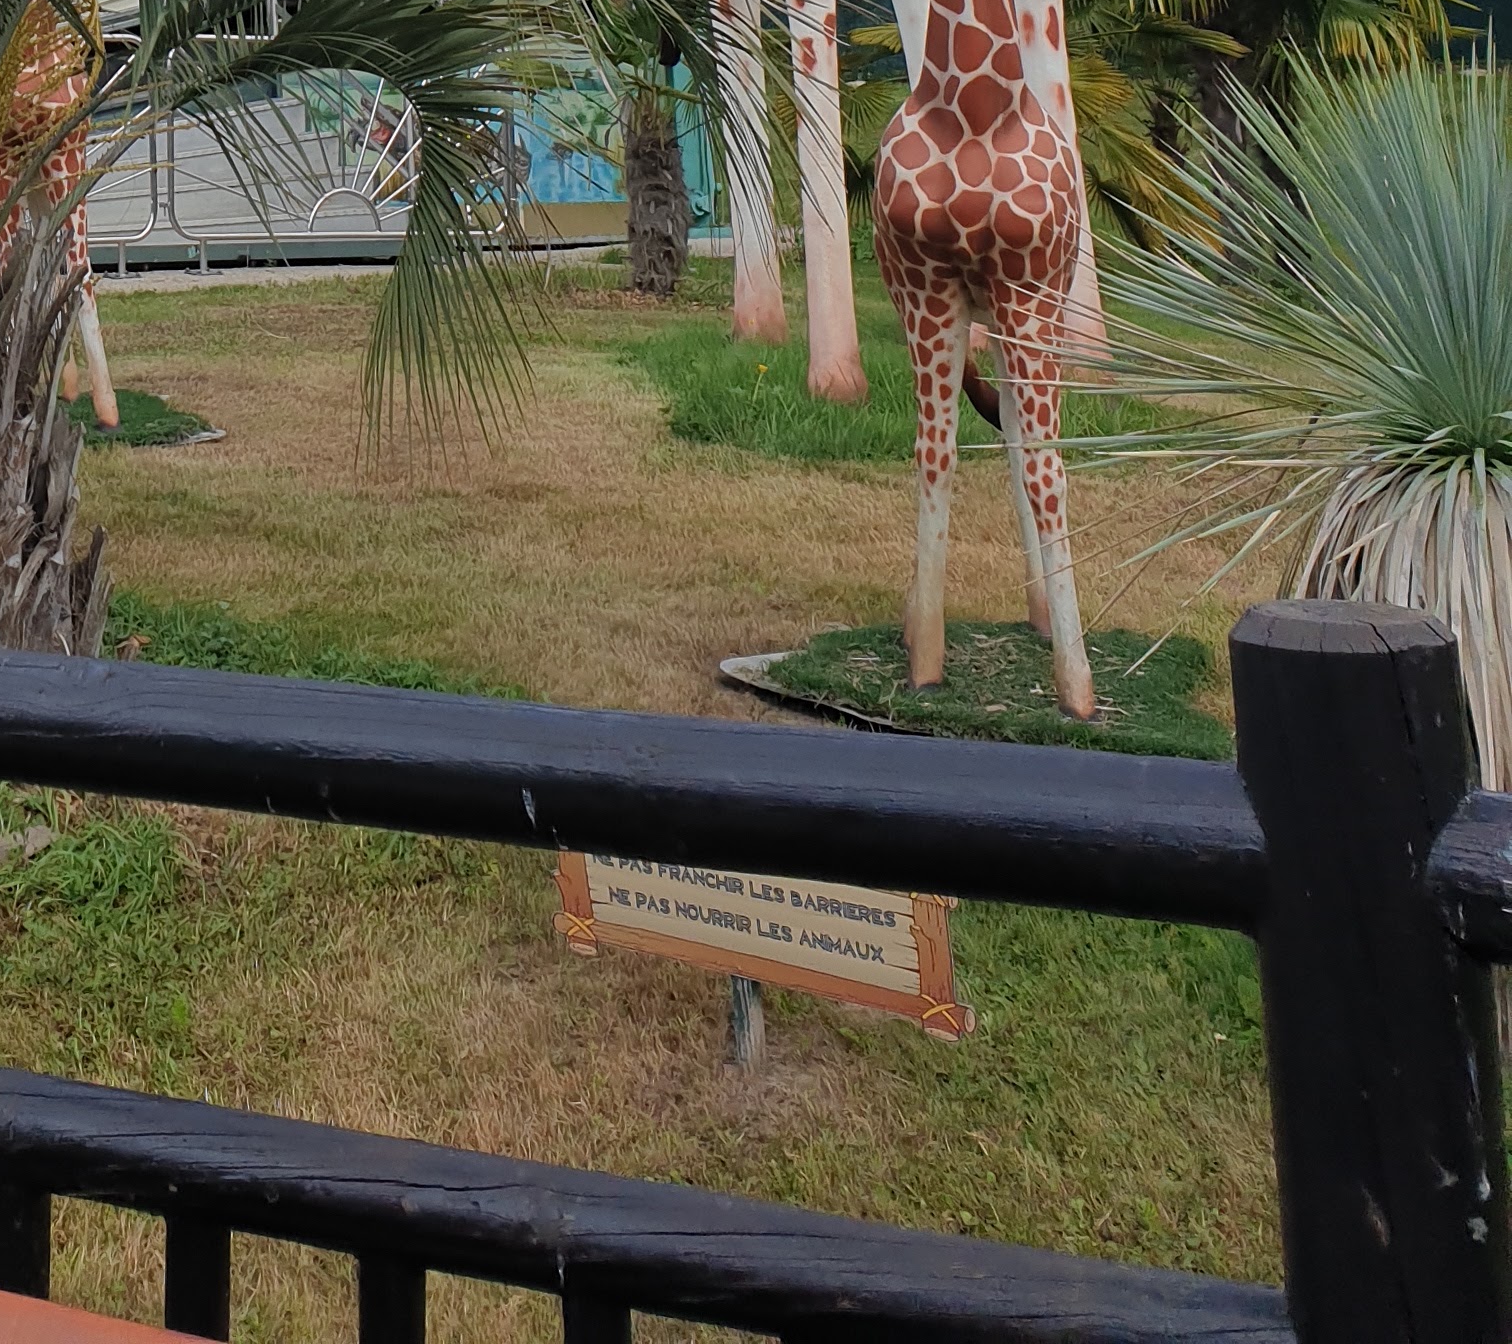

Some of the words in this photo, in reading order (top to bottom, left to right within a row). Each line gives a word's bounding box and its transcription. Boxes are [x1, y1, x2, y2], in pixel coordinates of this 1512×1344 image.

[608, 886, 632, 907] NE
[635, 892, 671, 915] PAS
[674, 900, 752, 934] NOURRIR
[756, 918, 793, 943] LES
[799, 929, 885, 964] ANIMAUX
[618, 858, 653, 875] PAS
[657, 863, 744, 896] FRANCHIR
[749, 880, 786, 904] LES
[790, 890, 897, 928] BARRIERES
